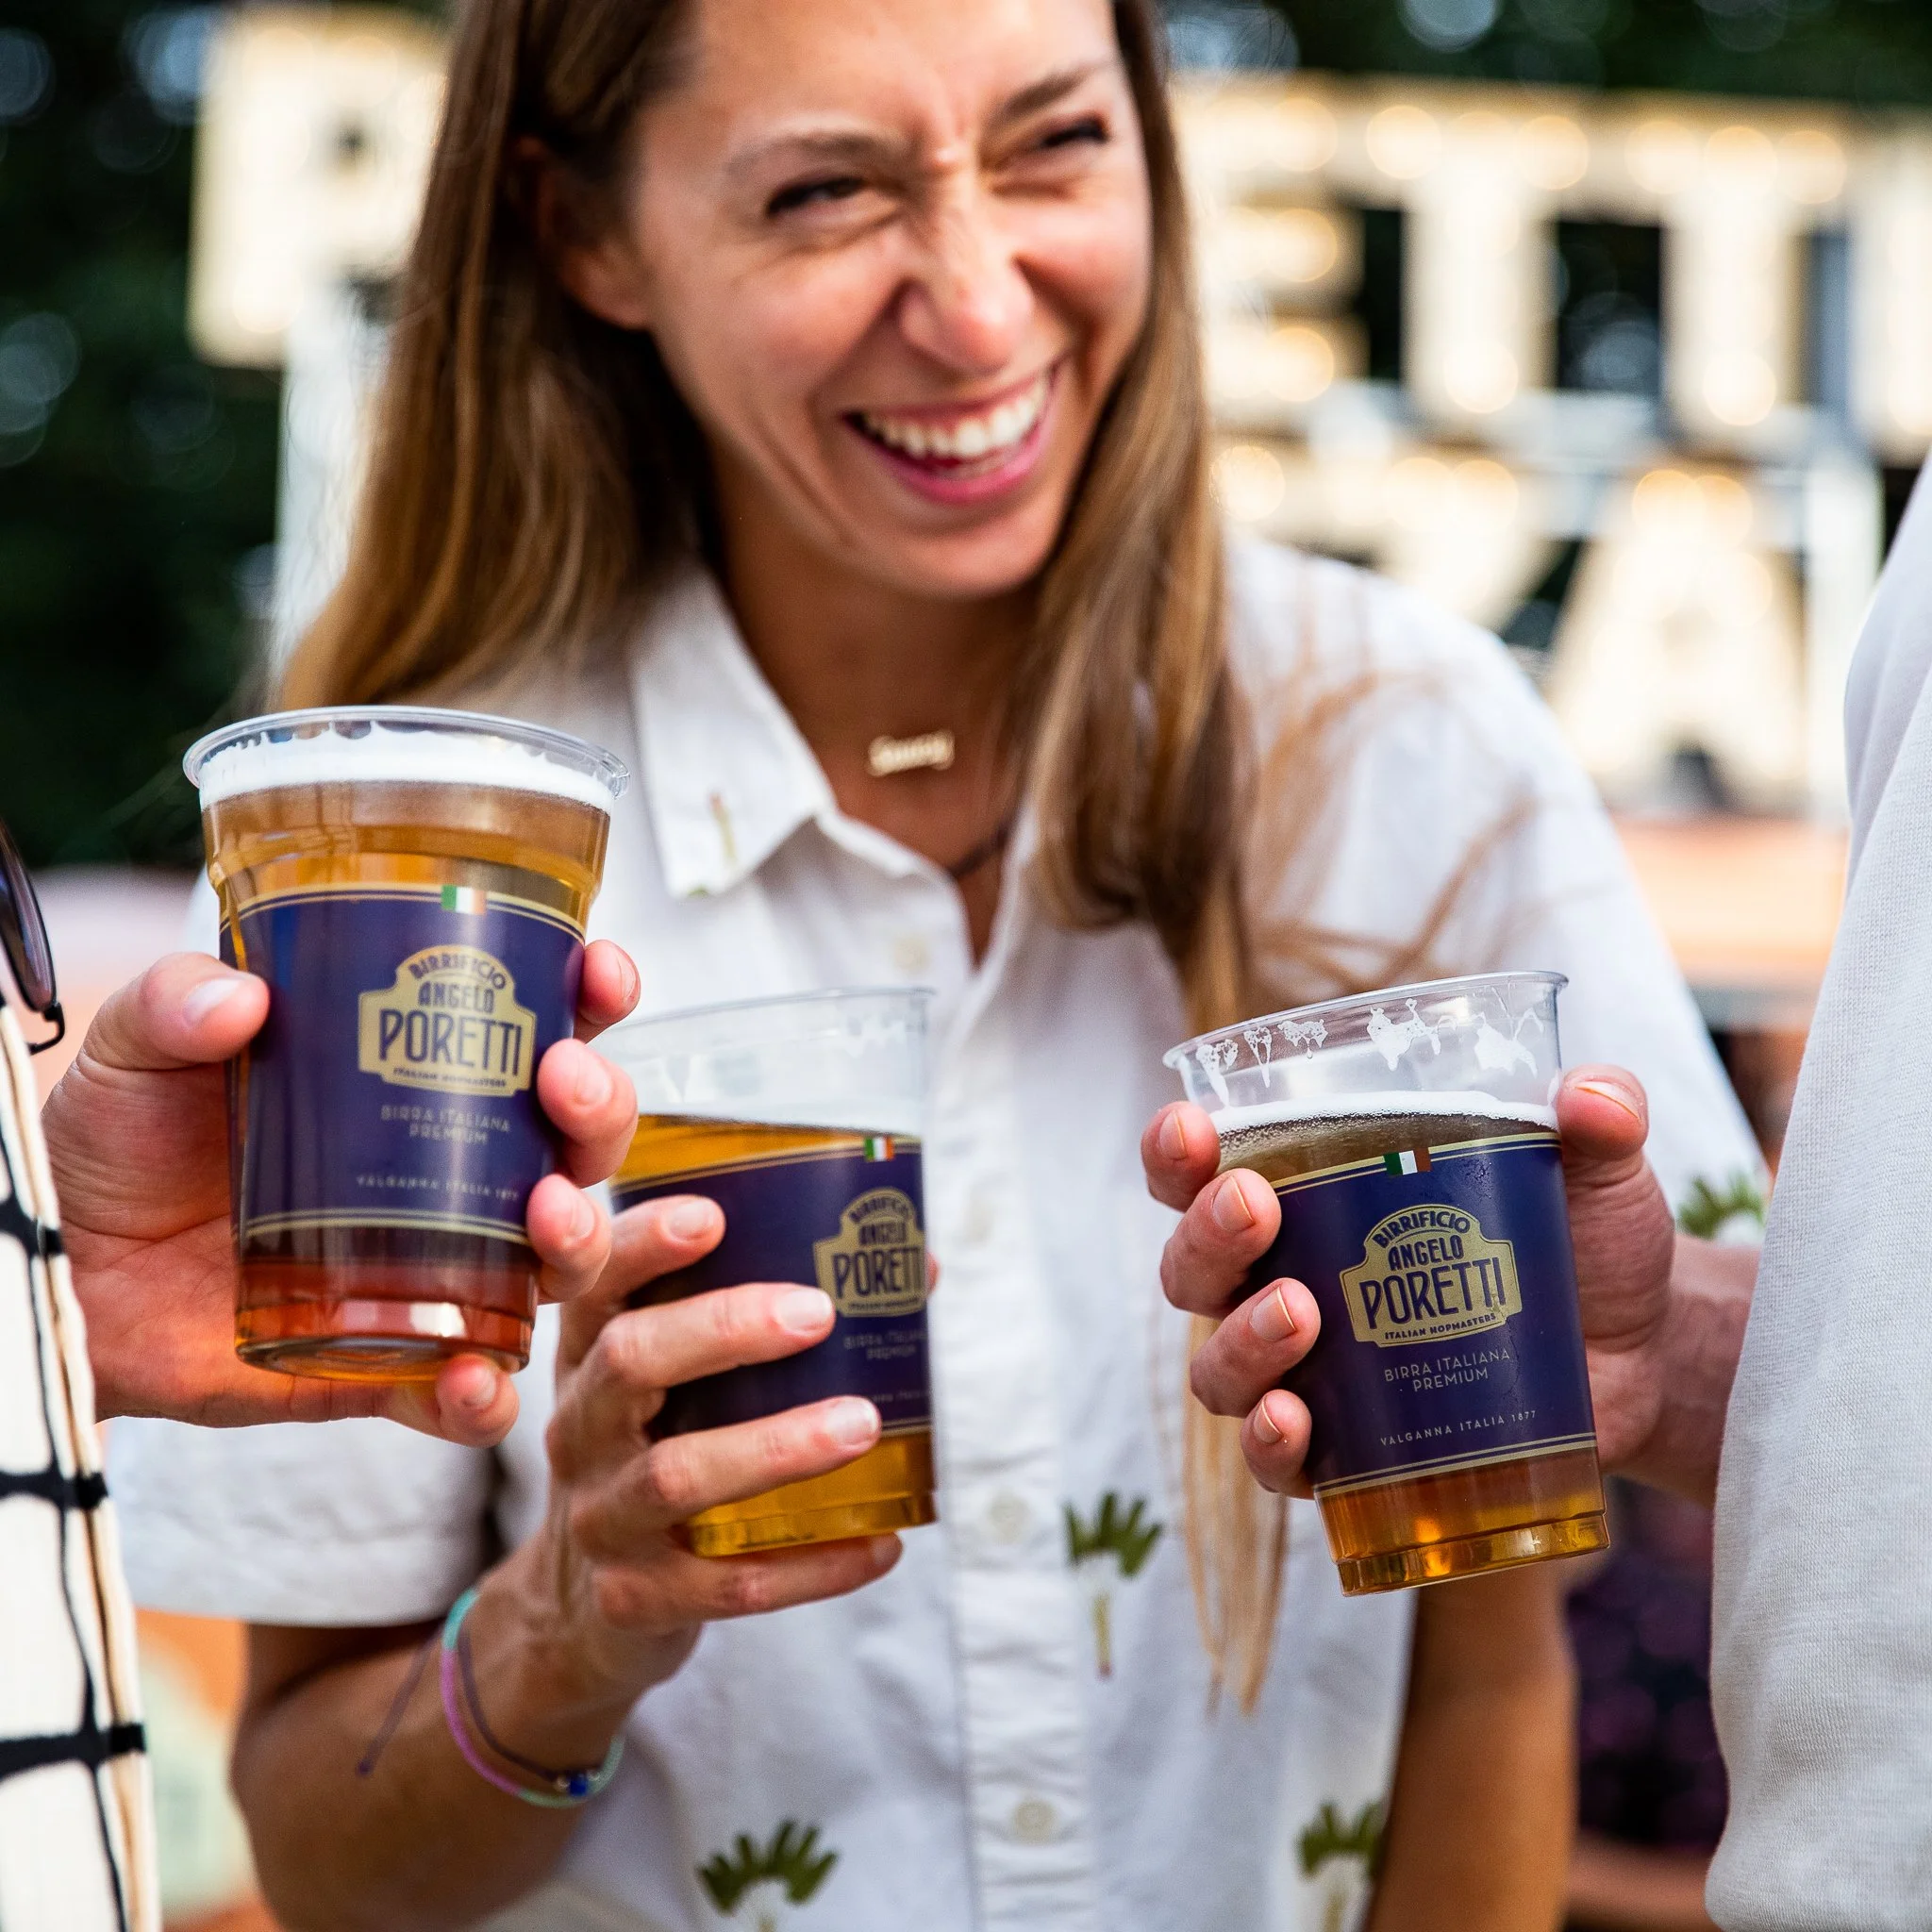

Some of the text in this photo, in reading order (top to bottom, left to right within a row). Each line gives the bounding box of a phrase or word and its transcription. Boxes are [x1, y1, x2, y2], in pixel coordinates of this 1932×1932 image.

[418, 981, 494, 1013] ANGELO
[379, 1008, 522, 1076] PORETTI
[1373, 1210, 1470, 1248] BIRRIFICIO
[1389, 1235, 1464, 1271] ANGELO
[1359, 1257, 1507, 1329] PORETTI
[1385, 1312, 1496, 1340] ITALIAN HOPMASTERS
[1384, 1348, 1509, 1382] BIRRA ITALIANA
[1413, 1367, 1488, 1392] PREMIUM
[1380, 1410, 1536, 1446] VALGANNA ITALIA 1877
